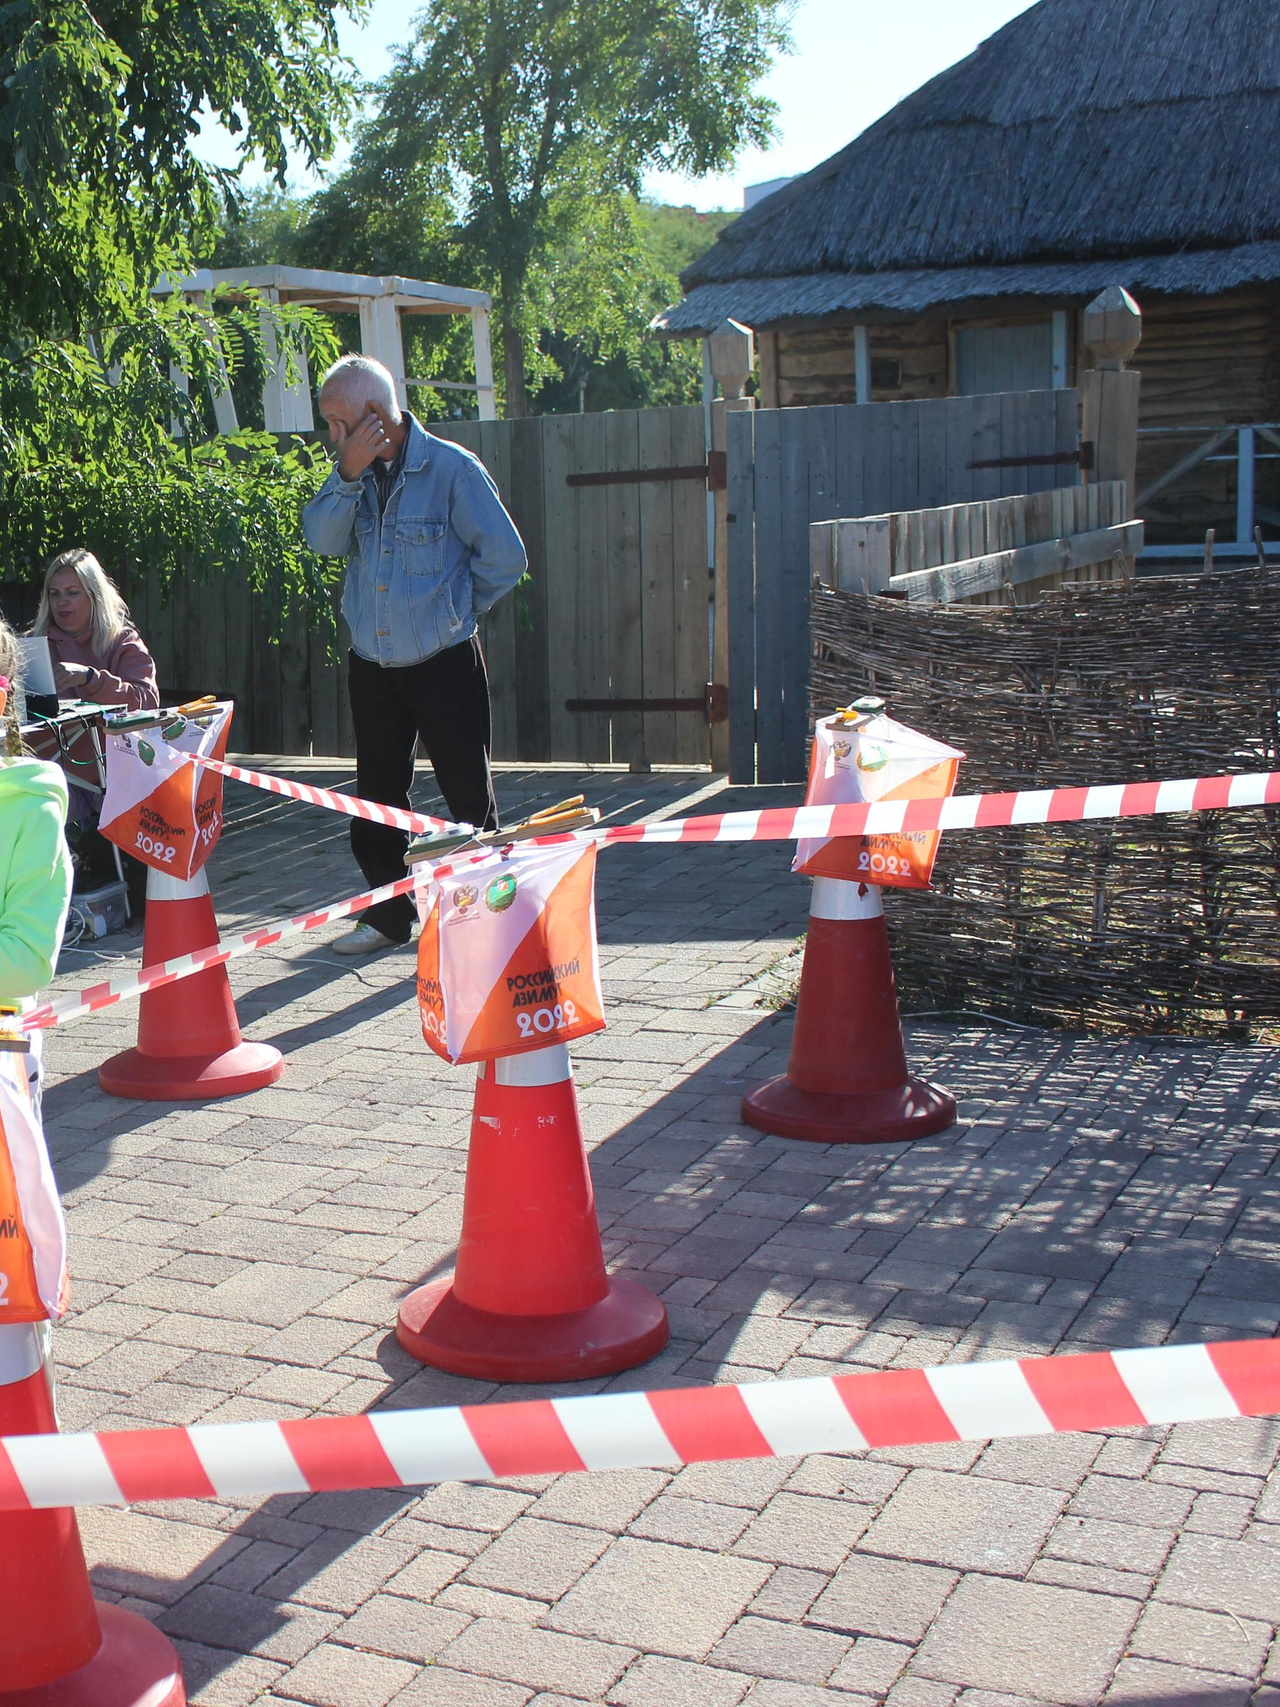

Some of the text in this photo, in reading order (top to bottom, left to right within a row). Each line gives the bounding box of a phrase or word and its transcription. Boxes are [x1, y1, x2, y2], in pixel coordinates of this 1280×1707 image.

[134, 831, 177, 864] 2022
[856, 851, 912, 878] 2022
[512, 982, 563, 1009] АЗИМУТ
[516, 999, 580, 1039] 2022
